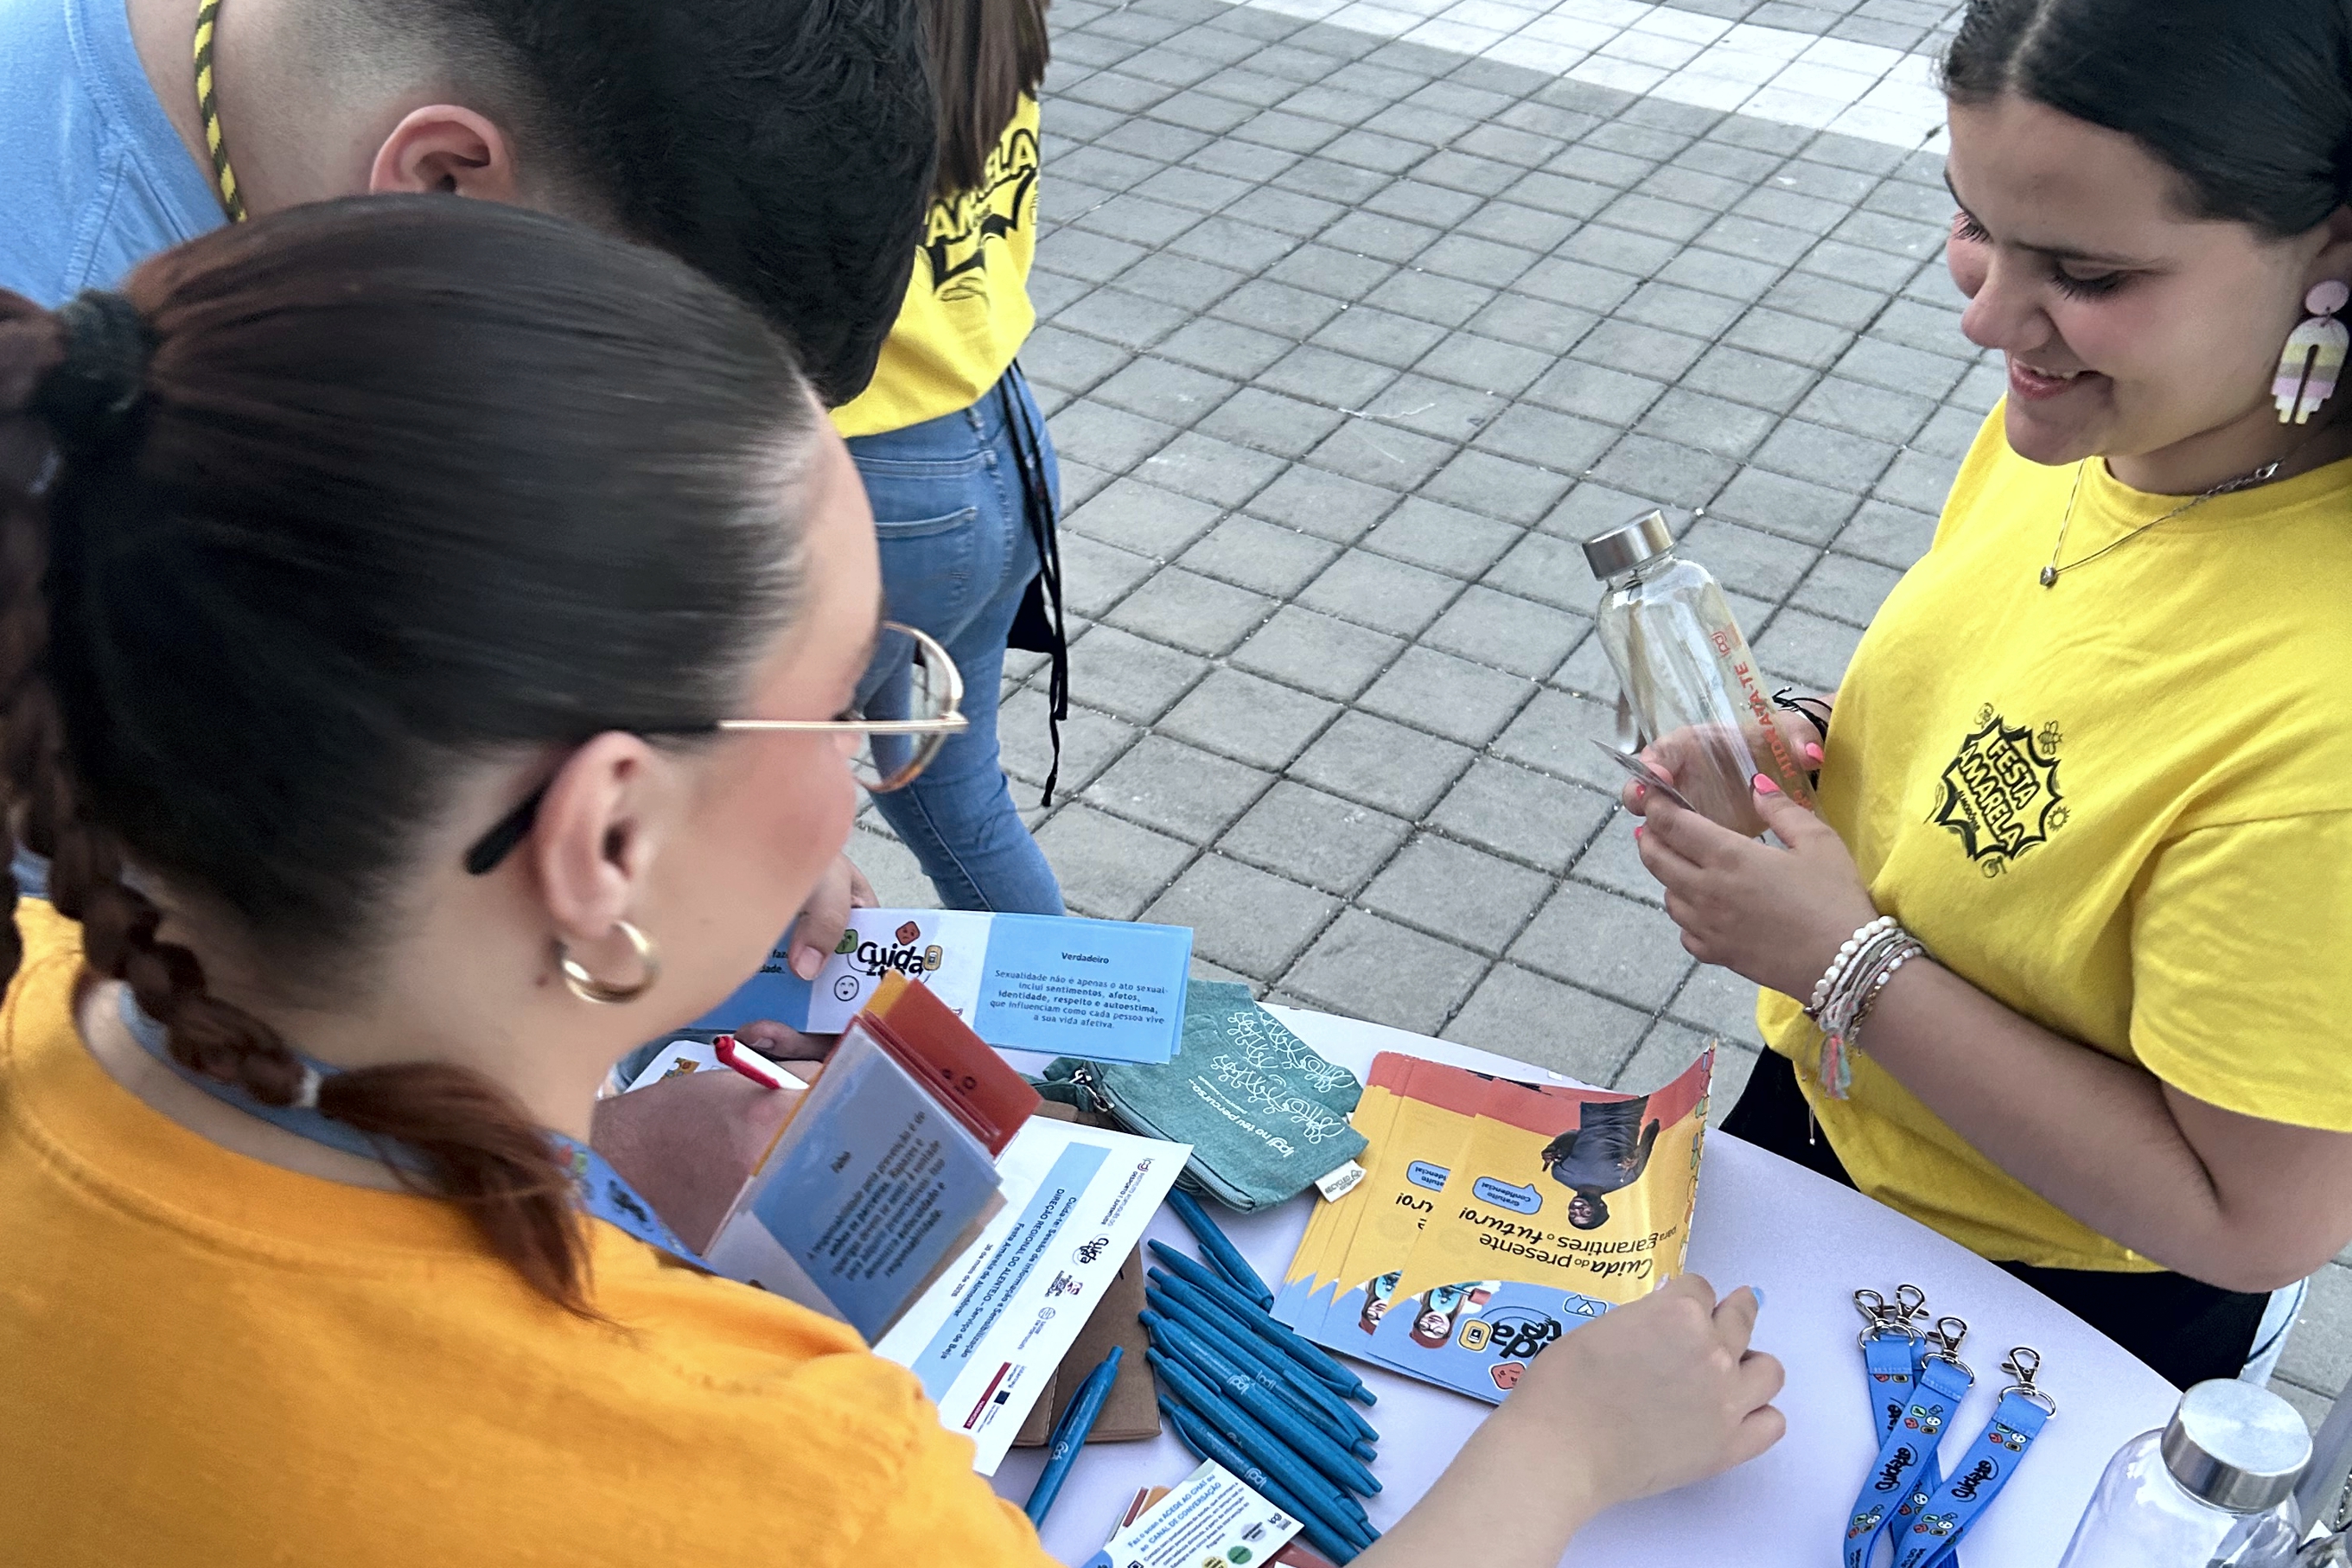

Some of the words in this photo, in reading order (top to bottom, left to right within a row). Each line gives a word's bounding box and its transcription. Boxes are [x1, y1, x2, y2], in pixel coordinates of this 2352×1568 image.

[1734, 661, 1797, 779] HIDRATA-TE
[1986, 736, 2041, 810] FESTA
[1957, 742, 2024, 857] AMARELA
[857, 941, 924, 974] Cuida
[1060, 951, 1109, 965] Verdadeiro
[994, 969, 1047, 983] Sexualidade
[1049, 973, 1066, 983] não
[1076, 978, 1108, 990] apenas
[1119, 982, 1133, 991] ato
[1018, 980, 1043, 991] inclui
[1045, 984, 1105, 998] sentimentos,
[1107, 991, 1140, 1003] afetos,
[989, 999, 1005, 1009] que
[1009, 999, 1061, 1013] influenciam
[1062, 1006, 1087, 1016] como
[1089, 1009, 1111, 1018] cada
[1112, 1012, 1143, 1023] pessoa
[1145, 1015, 1164, 1024] vive
[998, 989, 1049, 1002] identidade,
[1053, 995, 1092, 1008] respeito
[1102, 1000, 1158, 1014] autoestima,
[1041, 1014, 1056, 1023] sua
[1059, 1015, 1078, 1025] vida
[1080, 1017, 1114, 1029] afetiva.
[1236, 1115, 1255, 1132] teu
[1254, 1125, 1272, 1141] no
[1323, 1173, 1351, 1195] RECYCLED
[1413, 1166, 1447, 1181] idencial
[1420, 1175, 1444, 1187] atuito
[1394, 1191, 1434, 1214] uro!
[1479, 1181, 1533, 1202] Confidencial
[1485, 1191, 1521, 1208] Gratuito
[1038, 1186, 1066, 1221] DIREÇÃO
[1051, 1195, 1077, 1228] Cuida-te:
[1007, 1221, 1024, 1243] Festa
[1458, 1206, 1544, 1246] futuro!
[1546, 1233, 1556, 1241] o
[1015, 1219, 1044, 1257] REGIONAL
[1035, 1227, 1056, 1254] Sessão
[1557, 1232, 1657, 1256] garantires
[986, 1240, 1010, 1272] Amarela
[1007, 1253, 1020, 1268] DO
[1028, 1252, 1038, 1264] de
[1080, 1237, 1109, 1265] Cuida
[1479, 1232, 1572, 1271] presente
[1574, 1259, 1590, 1267] do
[1589, 1256, 1654, 1278] Cuida
[980, 1269, 991, 1281] de
[983, 1265, 1011, 1303] ALENTEJO
[959, 1303, 983, 1334] Serviço
[953, 1332, 963, 1343] de
[959, 1305, 1001, 1361] Sensibilização
[940, 1340, 957, 1361] Beja
[1161, 1500, 1183, 1519] ACEDE
[1181, 1493, 1192, 1503] AO
[1189, 1479, 1208, 1495] CHAT
[1147, 1525, 1170, 1544] CANAL
[1168, 1517, 1179, 1528] DE
[1174, 1480, 1223, 1520] CONVERSAÇÃO
